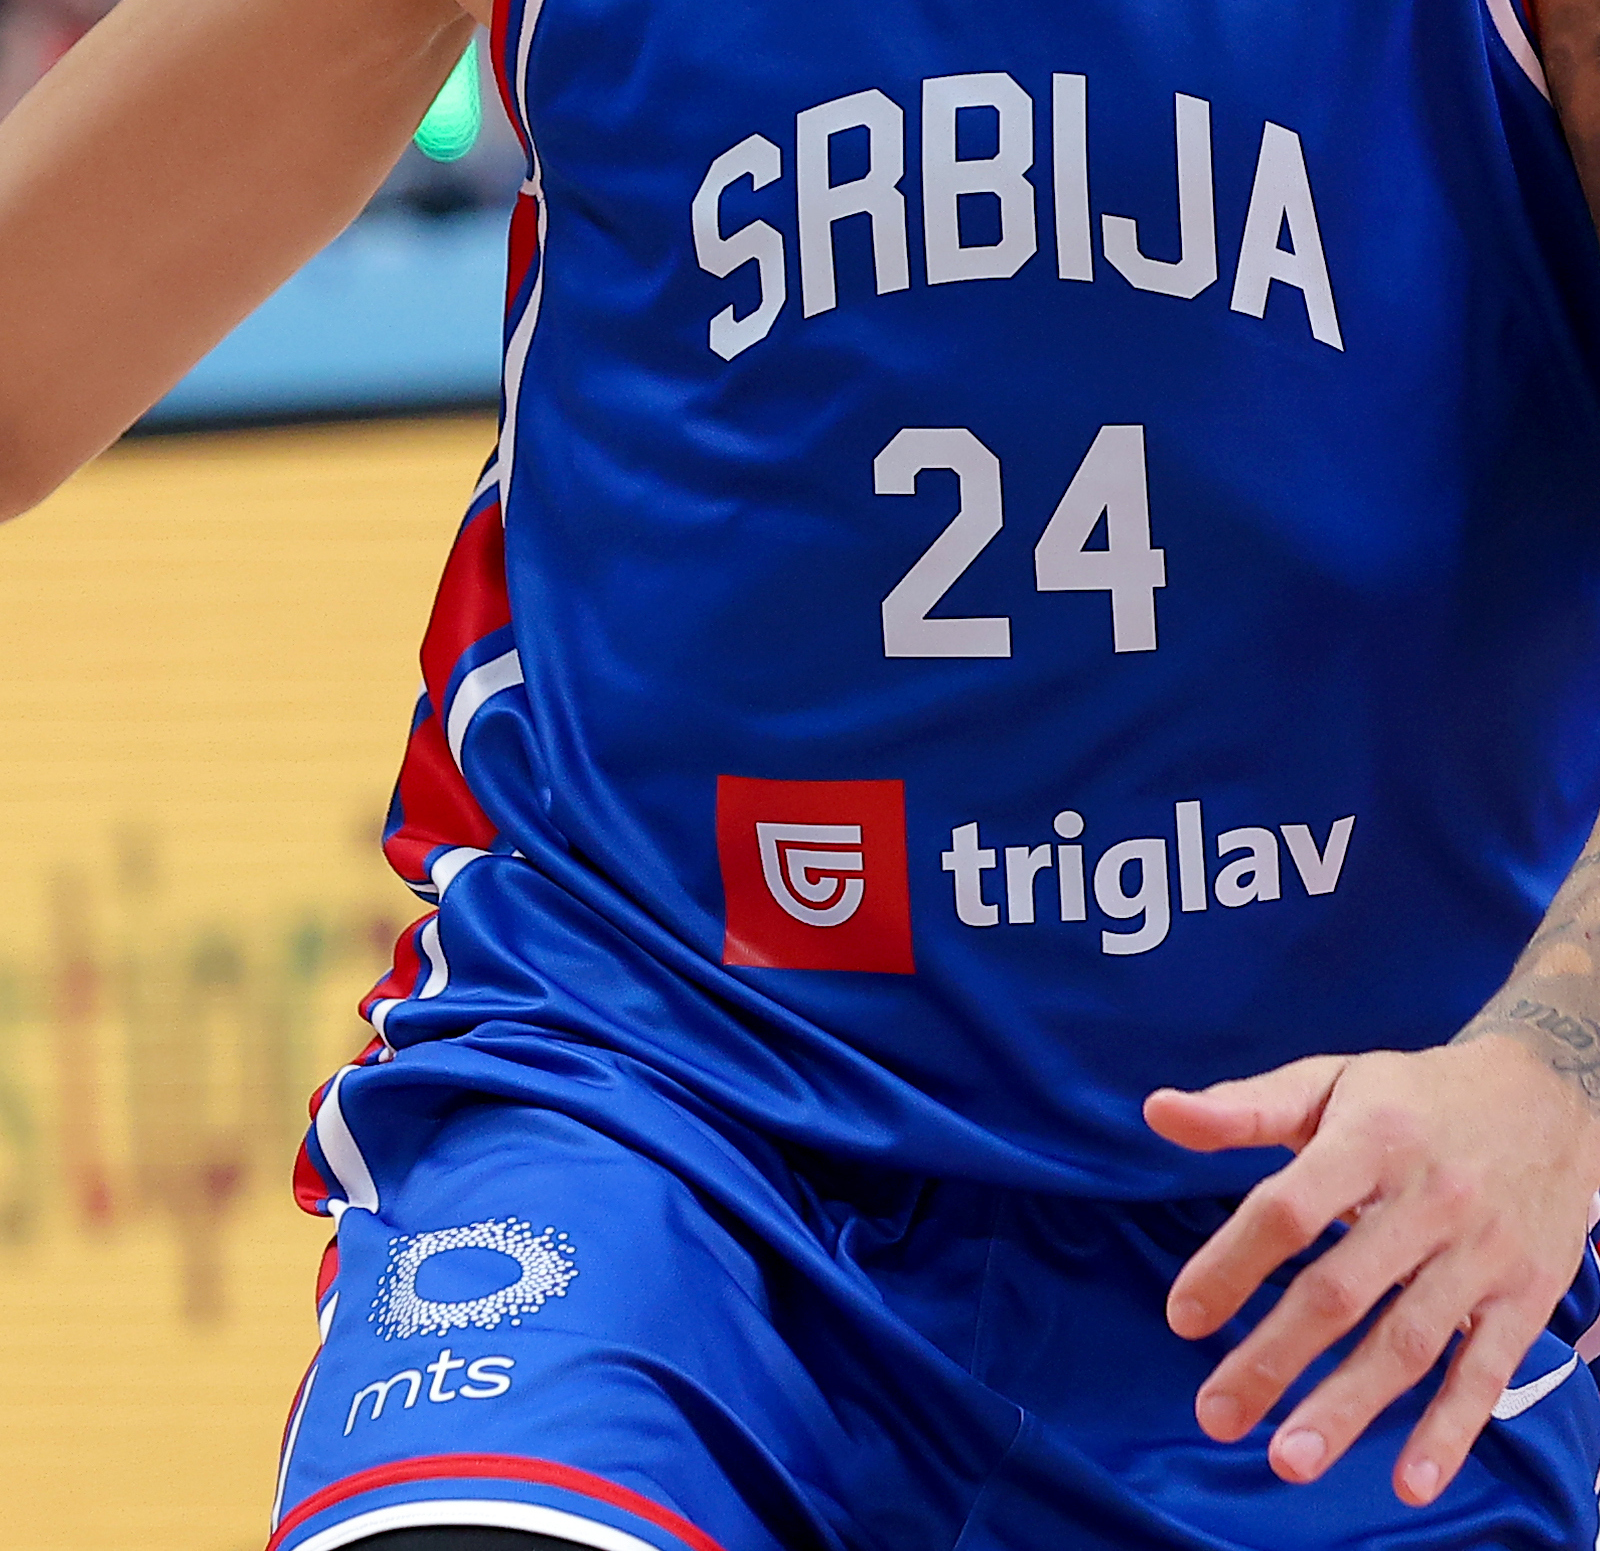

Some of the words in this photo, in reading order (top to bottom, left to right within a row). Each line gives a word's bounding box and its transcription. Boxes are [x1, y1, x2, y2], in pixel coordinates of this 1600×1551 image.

[691, 72, 1345, 362] SRBIJA
[873, 424, 1167, 658] 24
[941, 800, 1356, 956] triglav
[343, 1348, 516, 1438] mts
